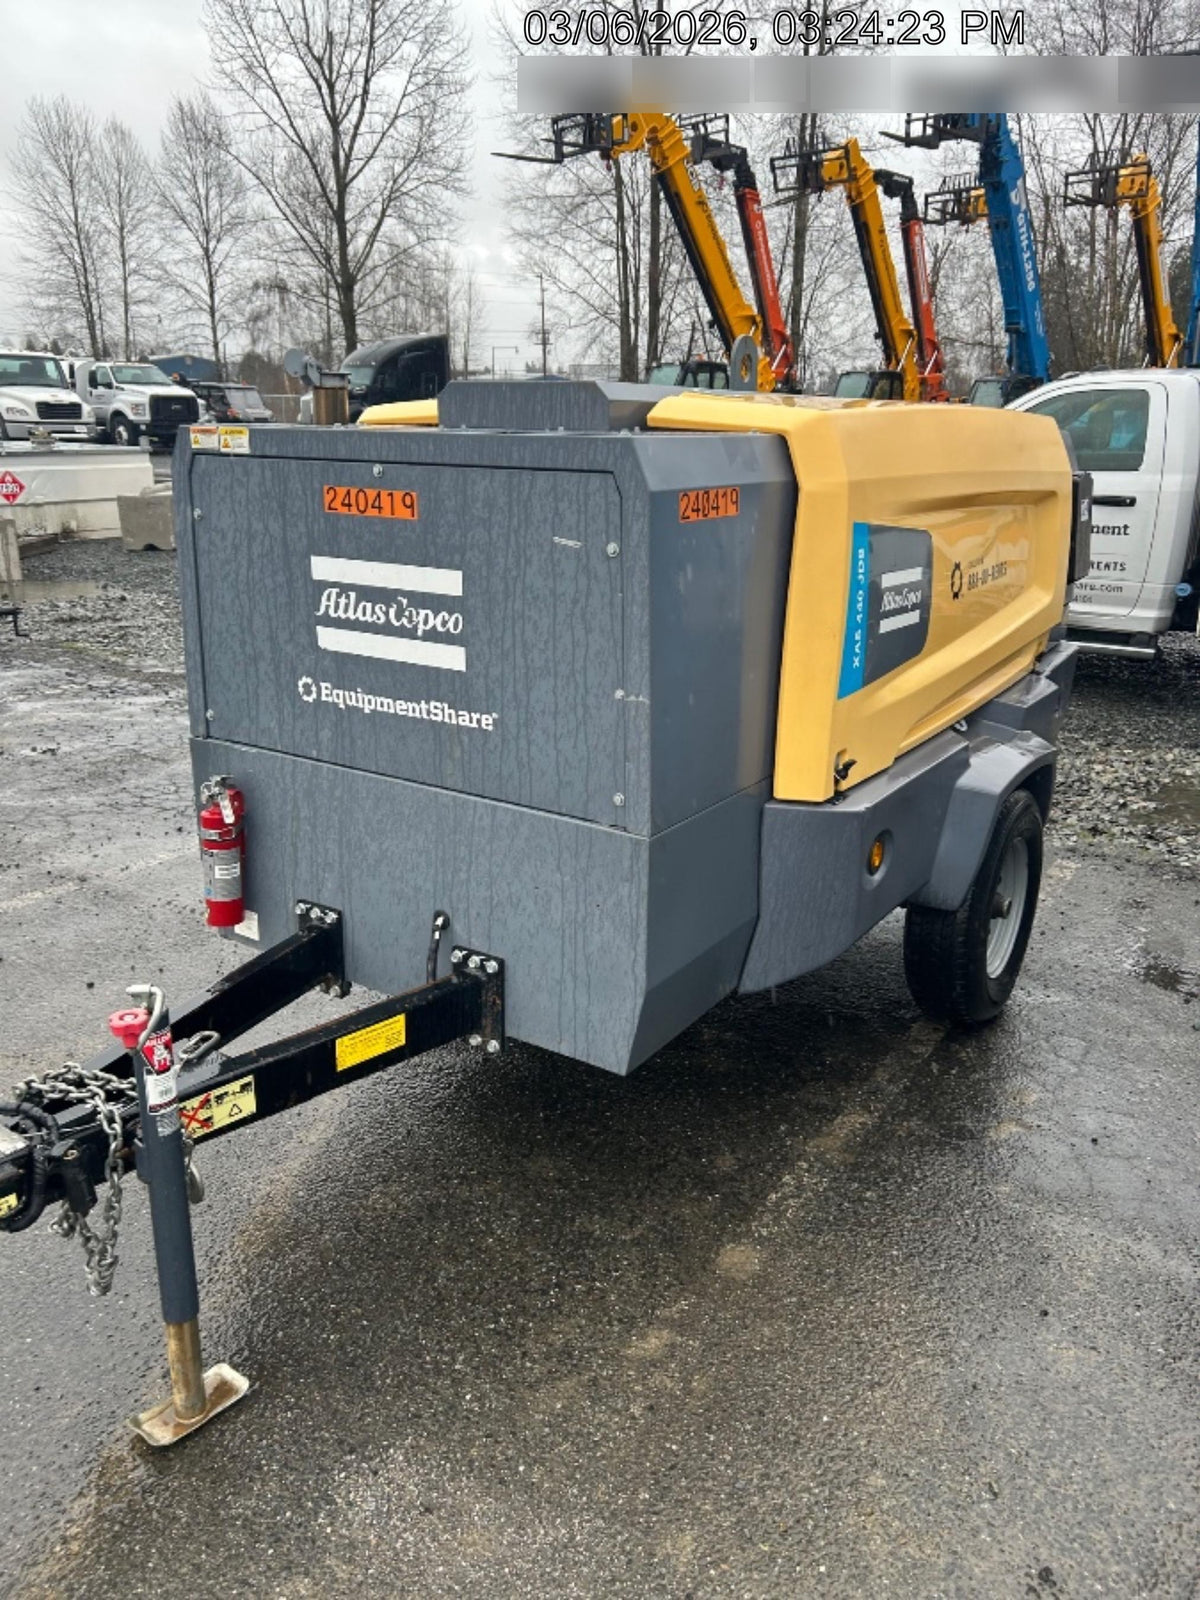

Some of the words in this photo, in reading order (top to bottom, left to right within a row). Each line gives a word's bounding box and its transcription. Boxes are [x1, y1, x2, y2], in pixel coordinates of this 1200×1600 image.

[326, 486, 416, 518] 240419
[680, 488, 739, 520] 240419
[315, 588, 386, 625] Atlas
[388, 596, 463, 637] Copco
